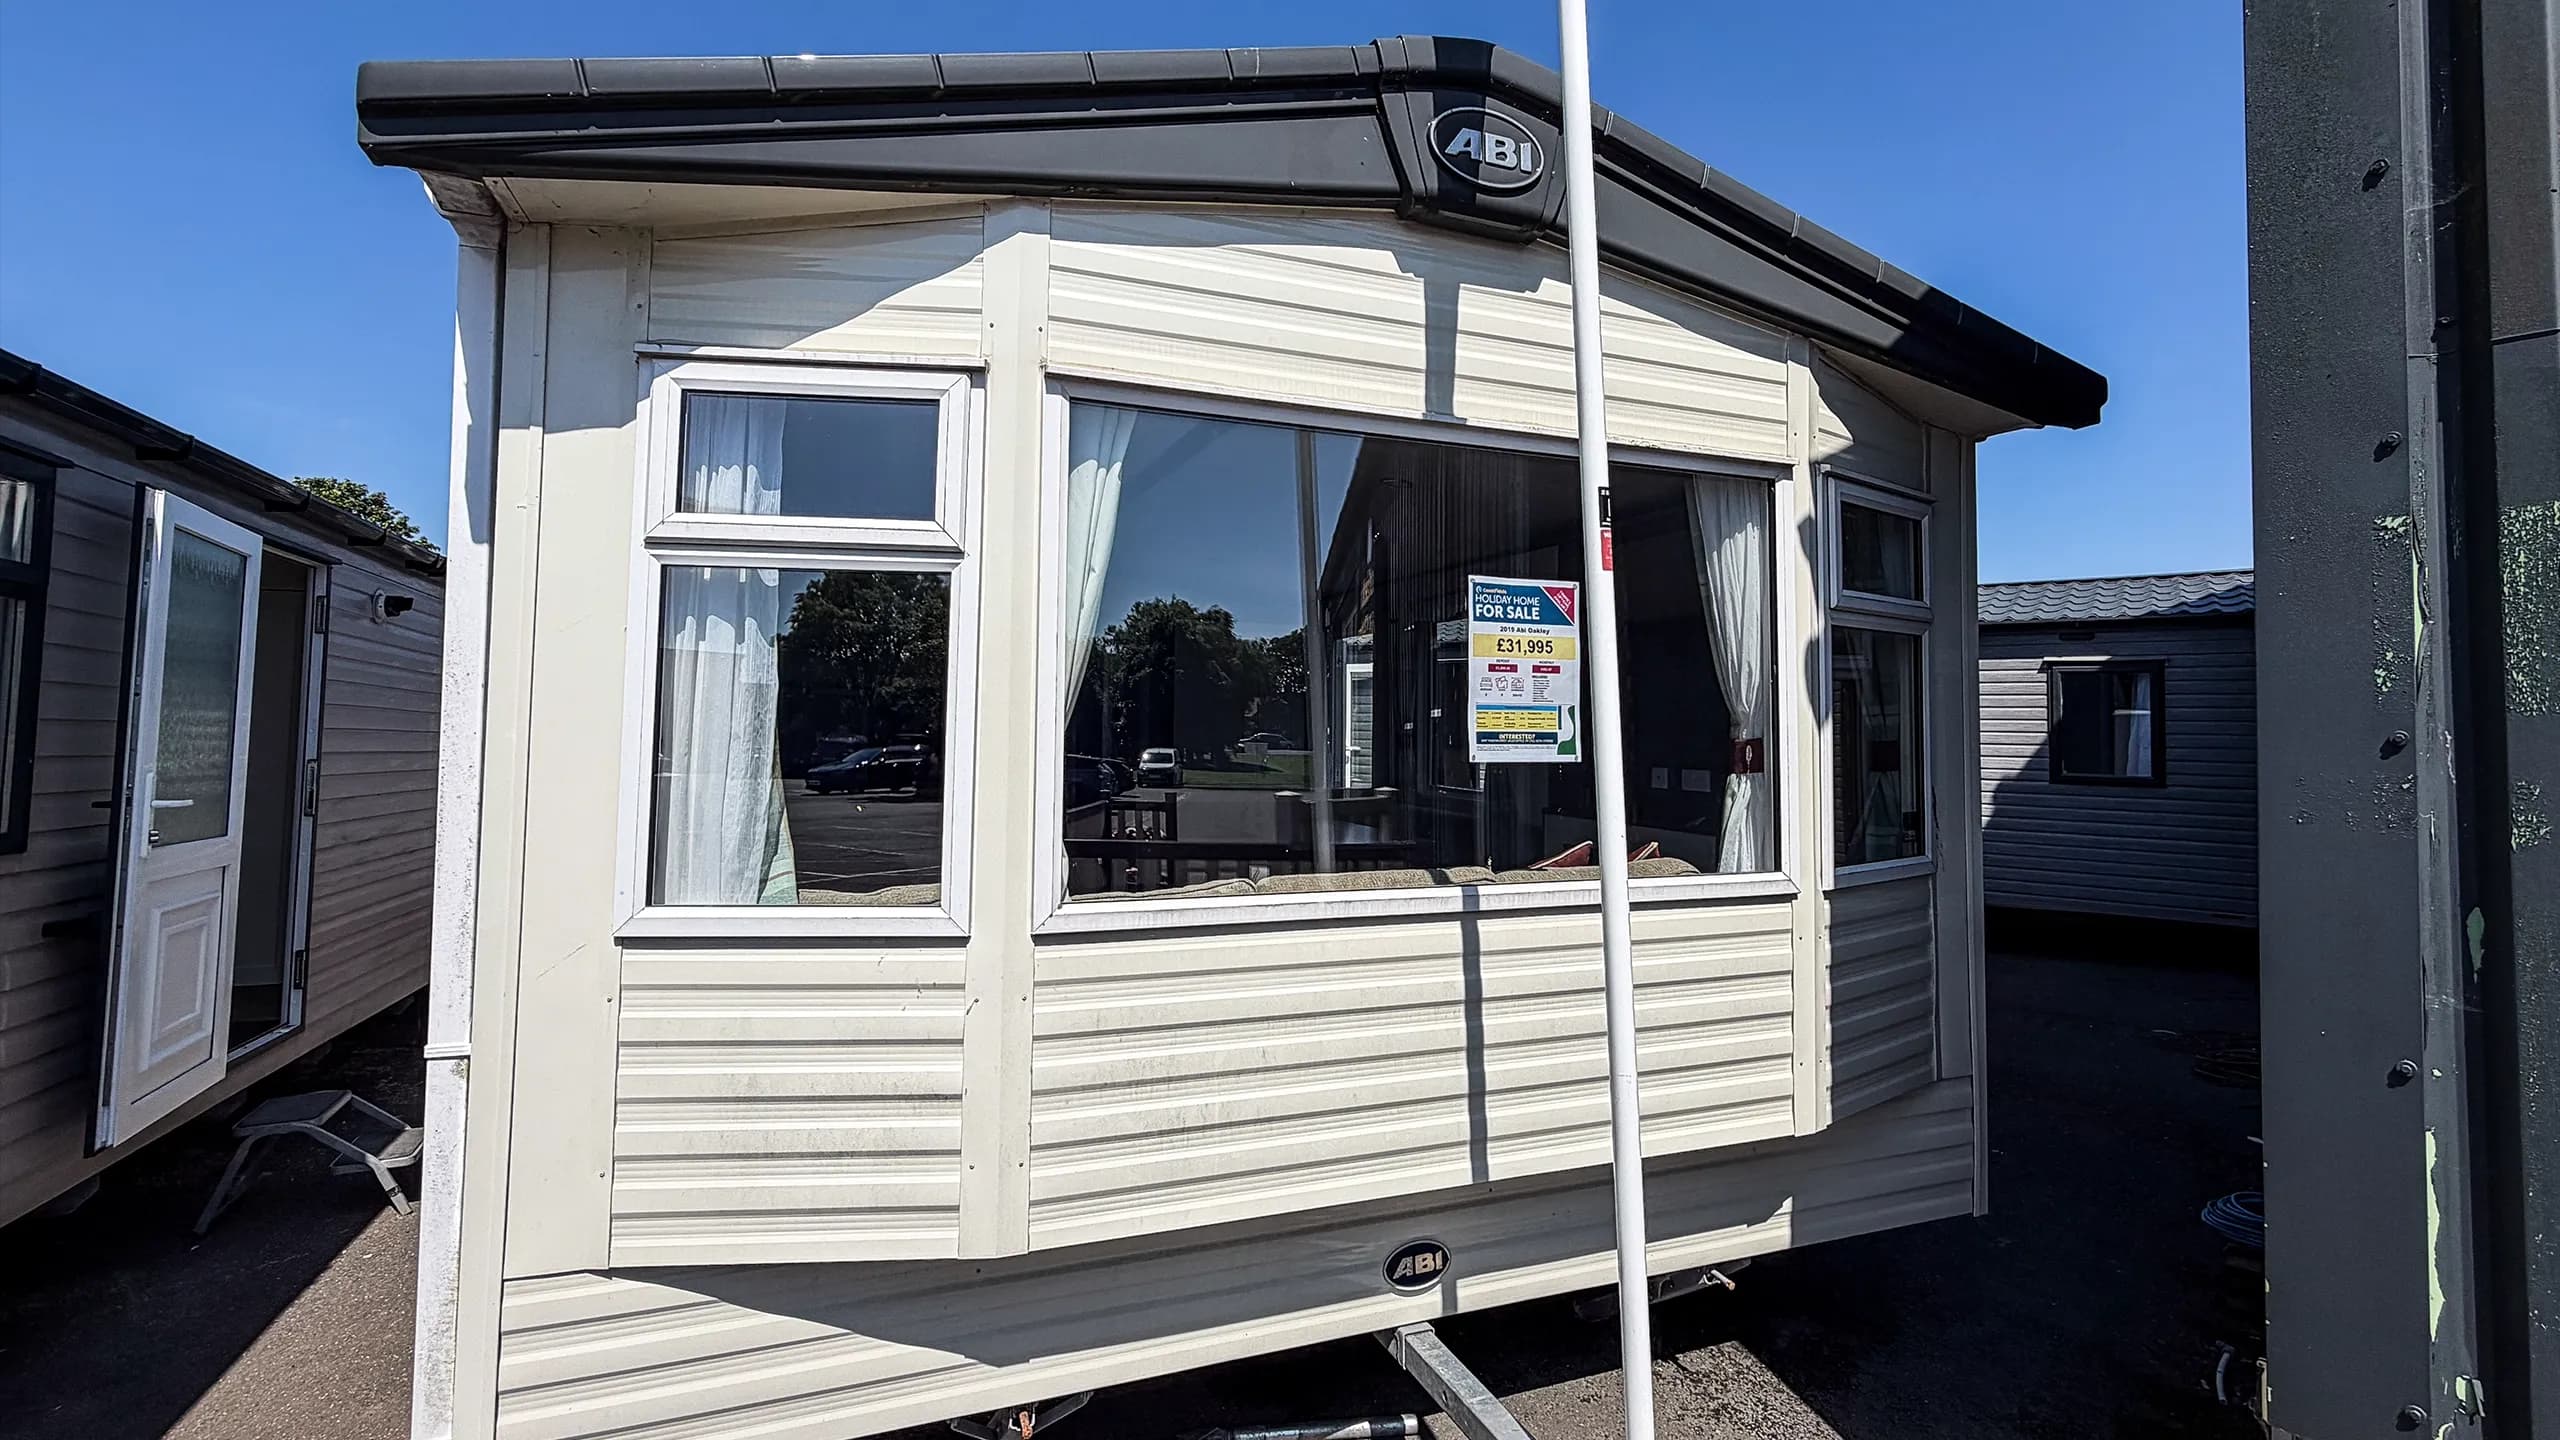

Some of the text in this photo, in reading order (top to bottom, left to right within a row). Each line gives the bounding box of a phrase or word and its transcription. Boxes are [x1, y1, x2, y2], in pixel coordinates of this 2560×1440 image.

[1445, 127, 1532, 173] ABI
[1475, 593, 1512, 605] HOLIDAY
[1513, 596, 1540, 607] HOME
[1475, 603, 1540, 620] FOR SALE
[1528, 627, 1550, 635] Oakley
[1496, 638, 1553, 656] £31,995
[1392, 1249, 1444, 1280] ABI
